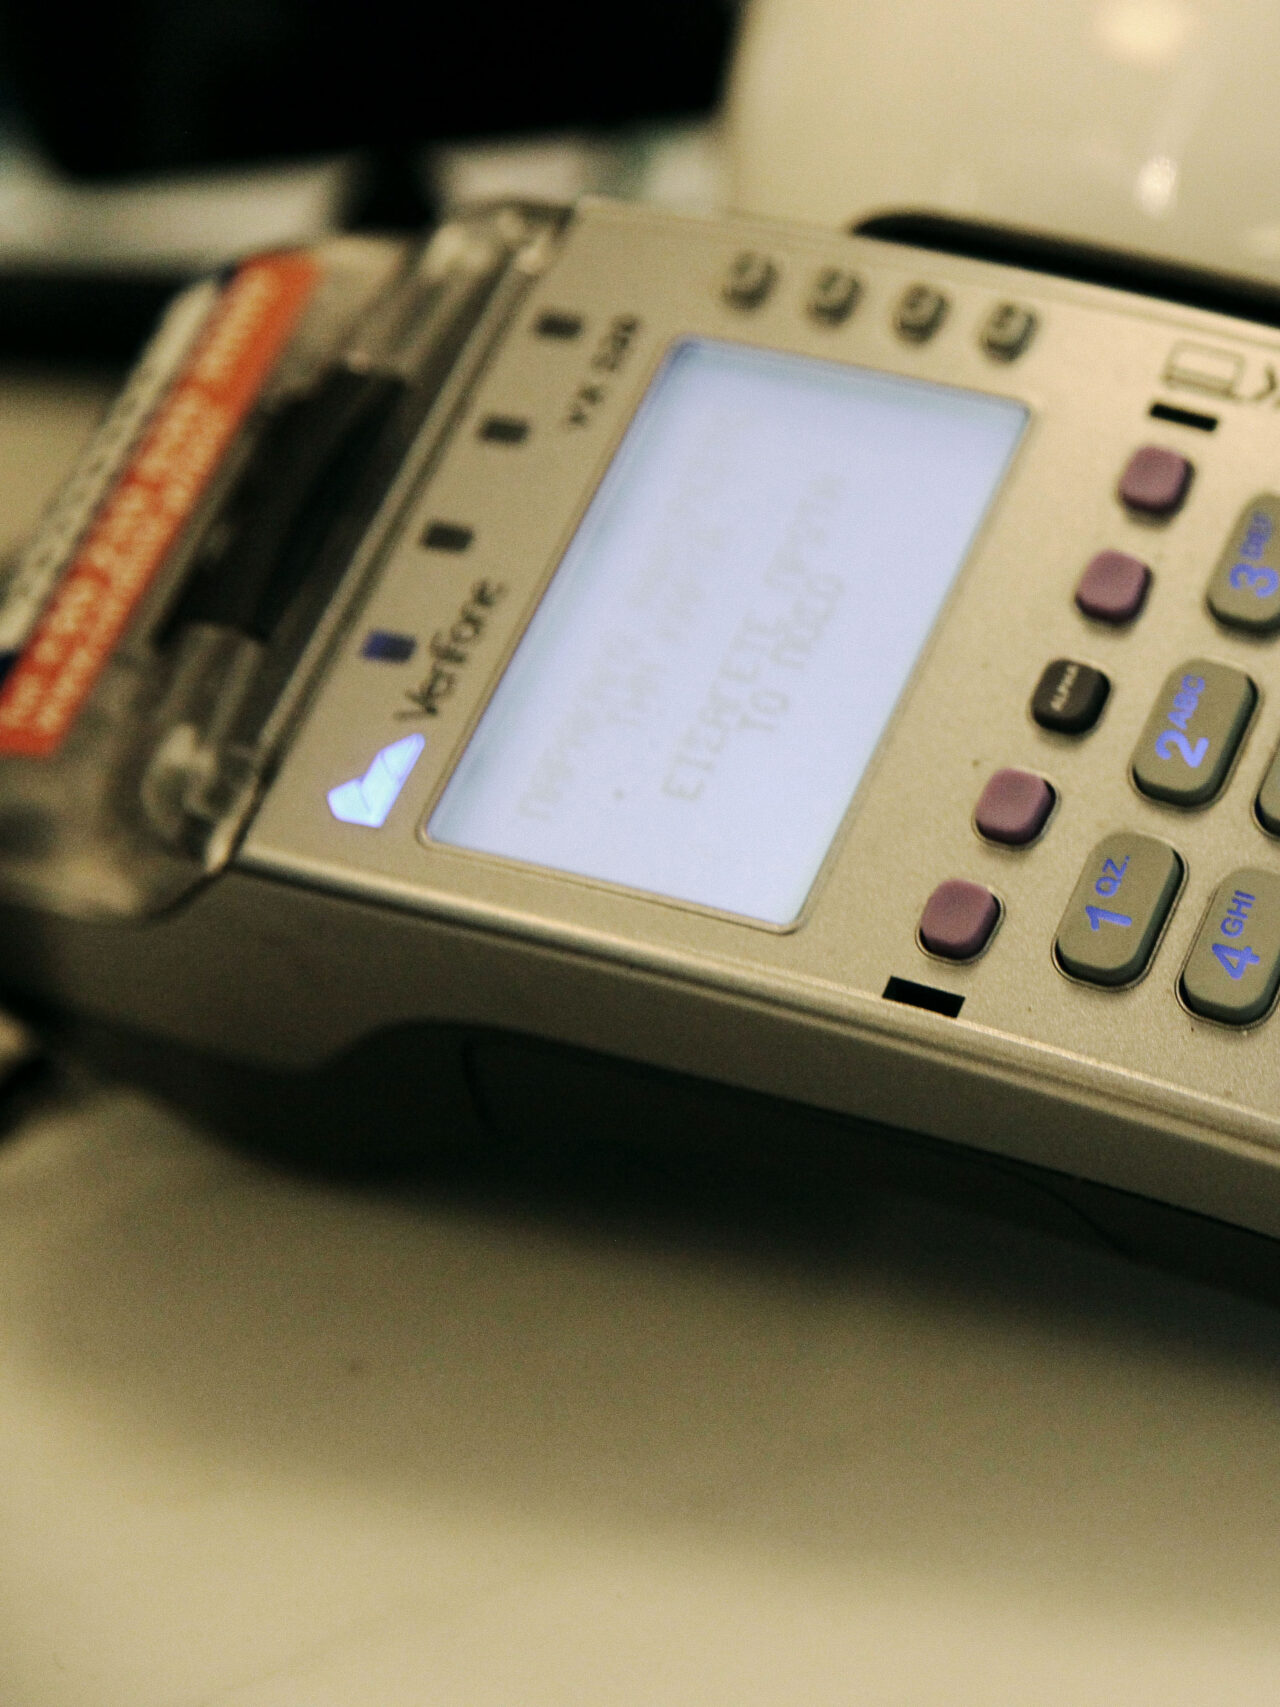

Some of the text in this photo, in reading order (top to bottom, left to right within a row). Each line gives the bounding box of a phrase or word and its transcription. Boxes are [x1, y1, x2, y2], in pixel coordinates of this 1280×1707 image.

[1230, 563, 1280, 598] 3
[1154, 674, 1210, 768] 2 ABC
[1085, 905, 1133, 932] 1
[1212, 890, 1261, 980] 4 GHI
